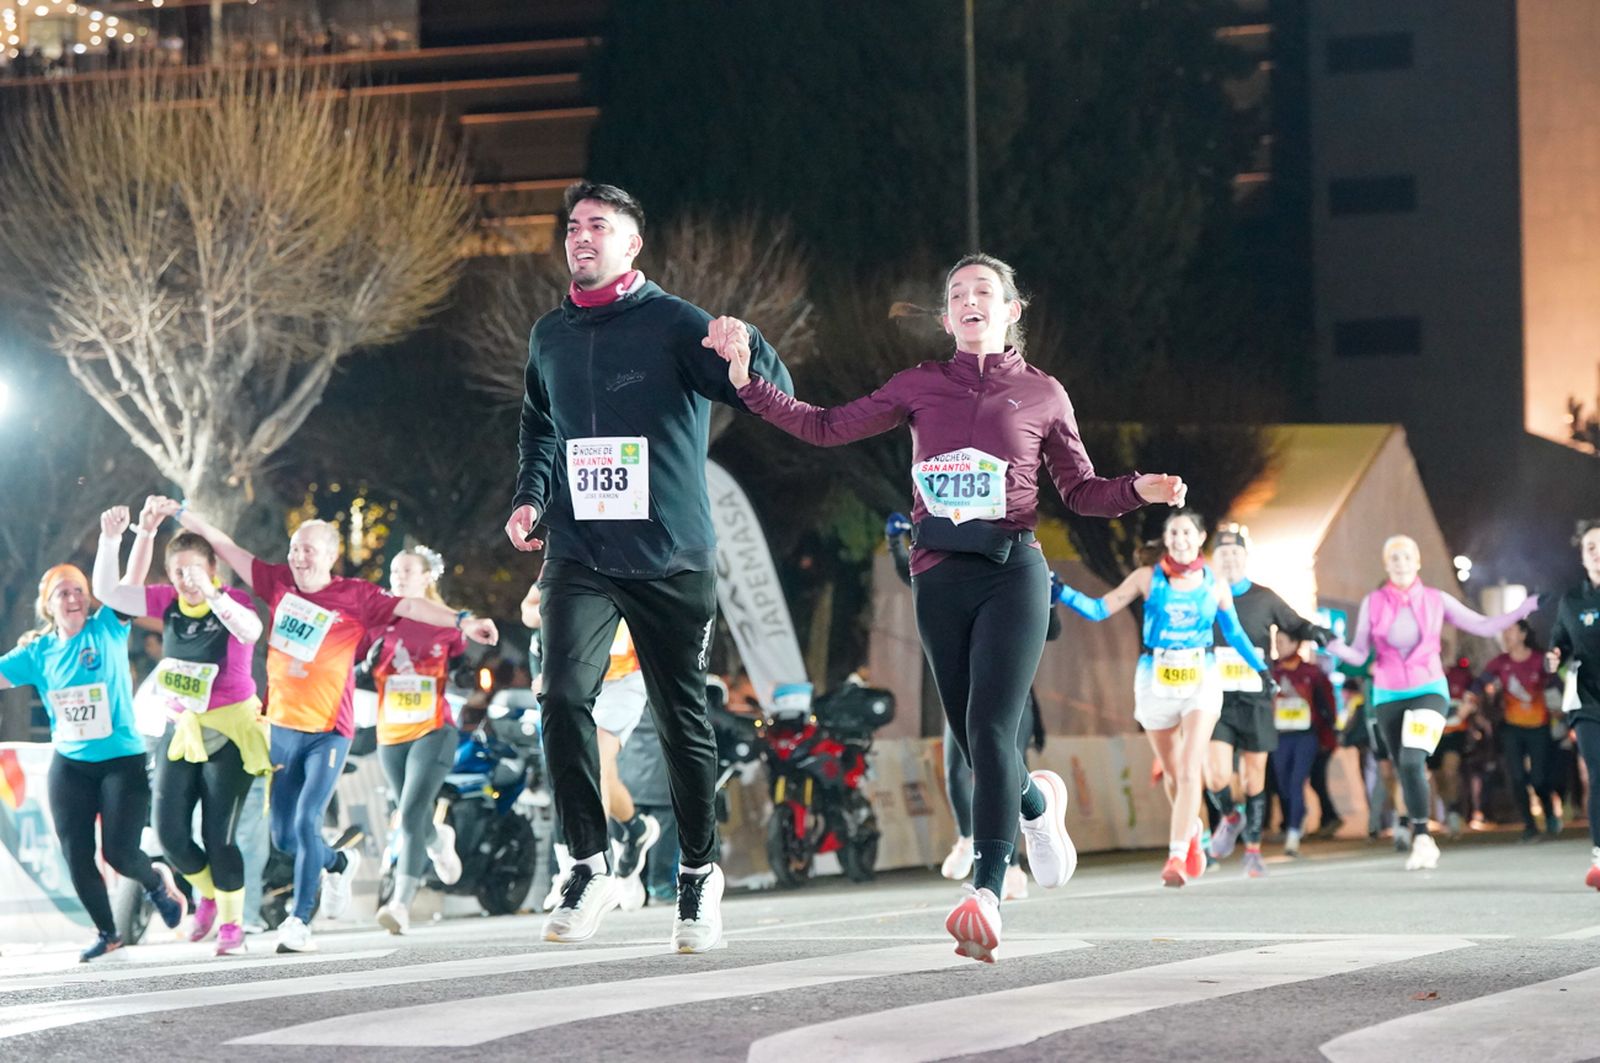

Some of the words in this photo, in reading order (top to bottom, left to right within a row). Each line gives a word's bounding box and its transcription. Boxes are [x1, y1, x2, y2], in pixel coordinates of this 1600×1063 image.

[580, 447, 602, 456] NOCHE
[603, 447, 613, 455] DE
[933, 453, 961, 463] NOCHE
[921, 463, 941, 472] SAN
[577, 467, 629, 492] 3133
[925, 472, 991, 498] 12133
[717, 489, 789, 640] JAPEMASA
[164, 671, 201, 693] 6838
[64, 704, 96, 722] 5227
